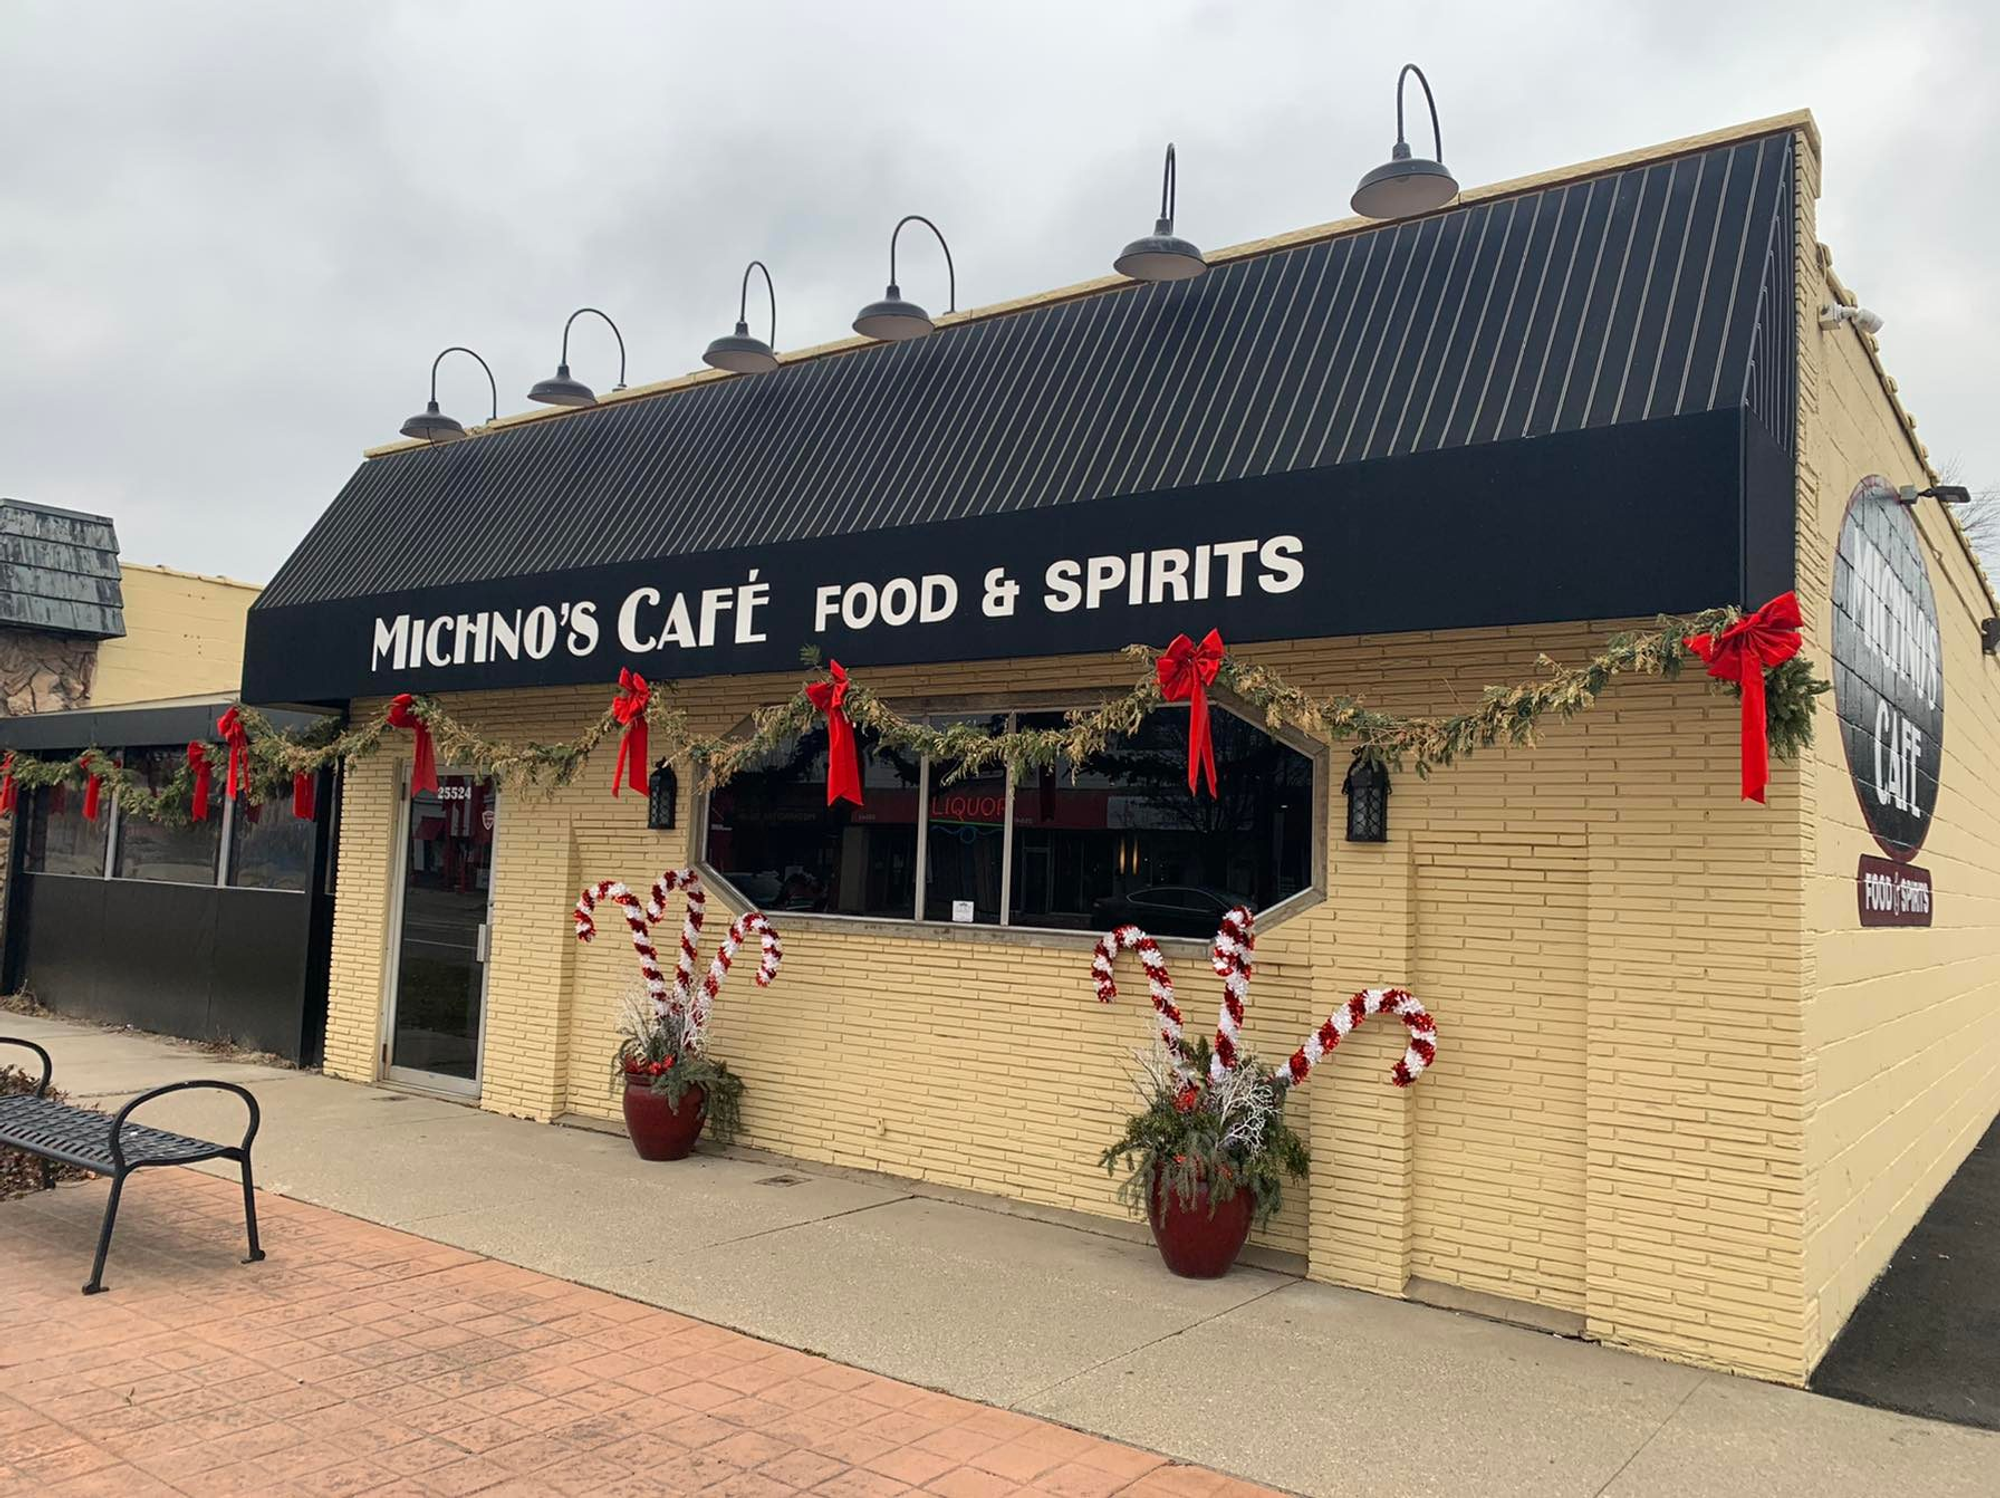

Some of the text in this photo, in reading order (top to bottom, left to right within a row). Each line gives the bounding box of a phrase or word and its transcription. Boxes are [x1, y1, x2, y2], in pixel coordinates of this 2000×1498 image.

[371, 534, 1305, 672] MICHNO'S CAFÉ FOOD & SPIRITS
[437, 786, 472, 800] 25524
[1865, 873, 1893, 911] FOOD
[1901, 878, 1930, 914] SPIRITS
